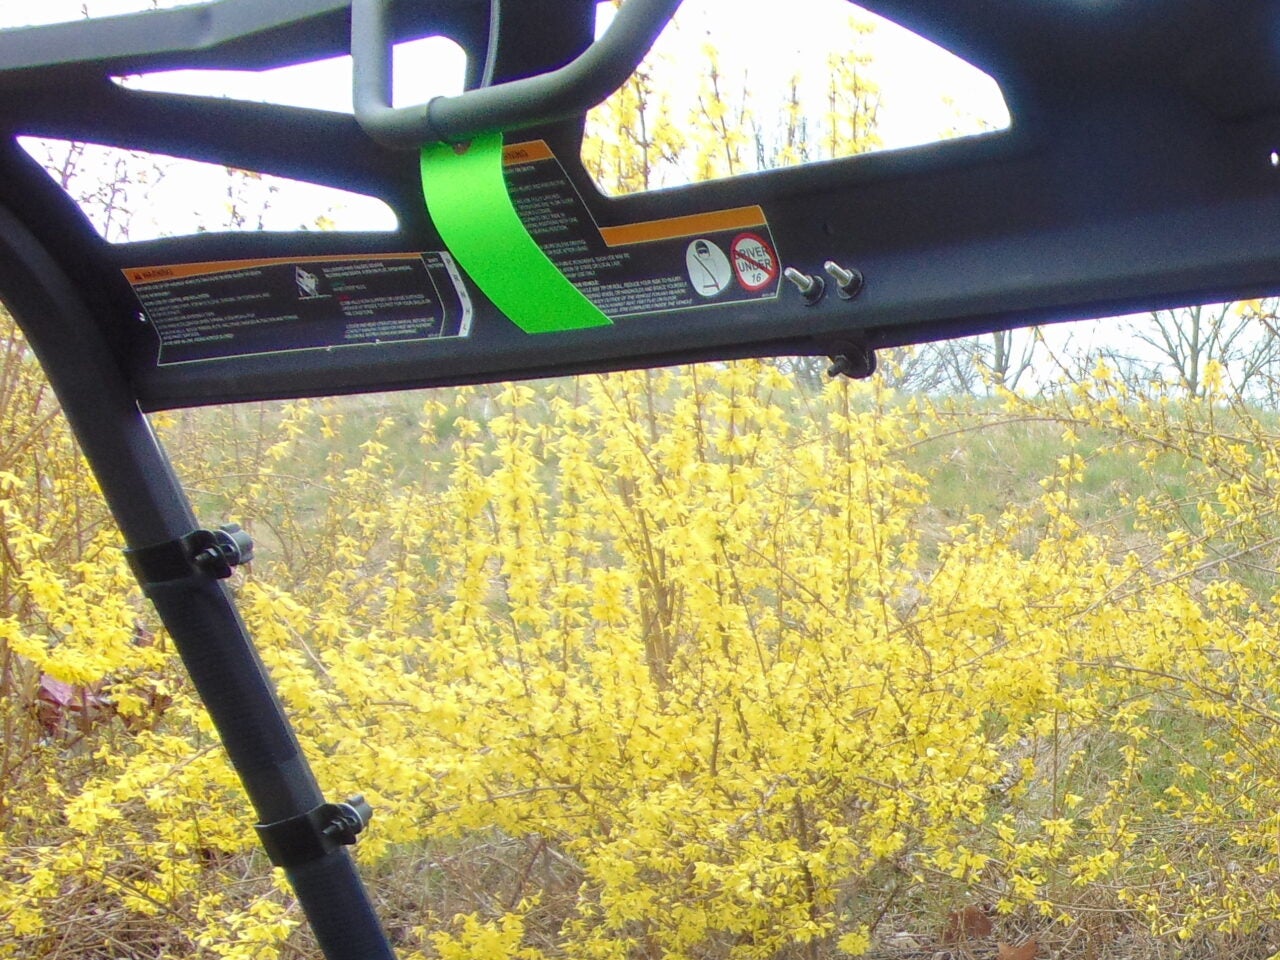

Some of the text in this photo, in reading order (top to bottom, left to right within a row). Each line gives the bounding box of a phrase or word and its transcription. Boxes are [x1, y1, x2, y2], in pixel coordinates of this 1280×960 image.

[733, 246, 769, 259] DRIVER
[737, 259, 773, 272] UNDER
[752, 273, 762, 283] 16
